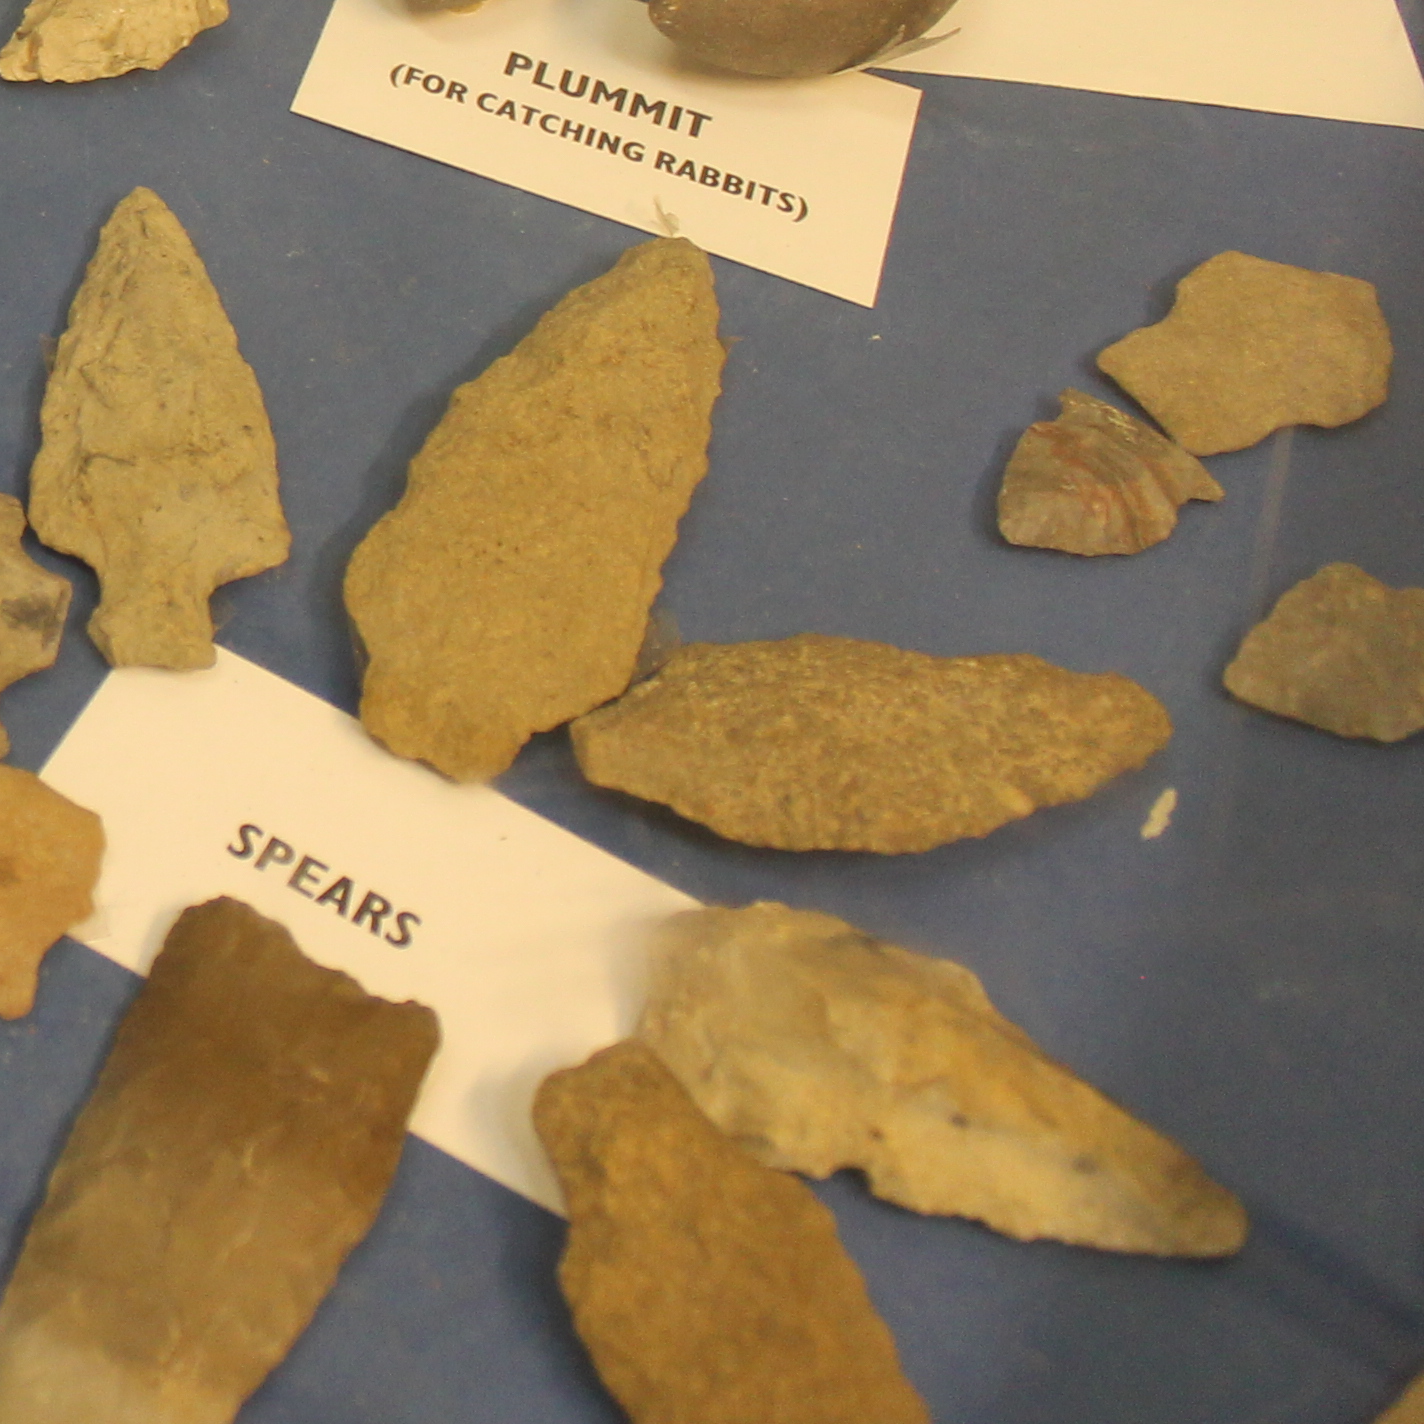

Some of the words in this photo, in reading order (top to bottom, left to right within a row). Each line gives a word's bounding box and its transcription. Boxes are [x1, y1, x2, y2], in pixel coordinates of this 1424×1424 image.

[388, 61, 469, 106] (FOR
[475, 90, 647, 167] CATCHING
[653, 147, 811, 224] RABBITS)
[502, 50, 713, 139] PLUMMIT
[226, 822, 423, 950] SPEARS
